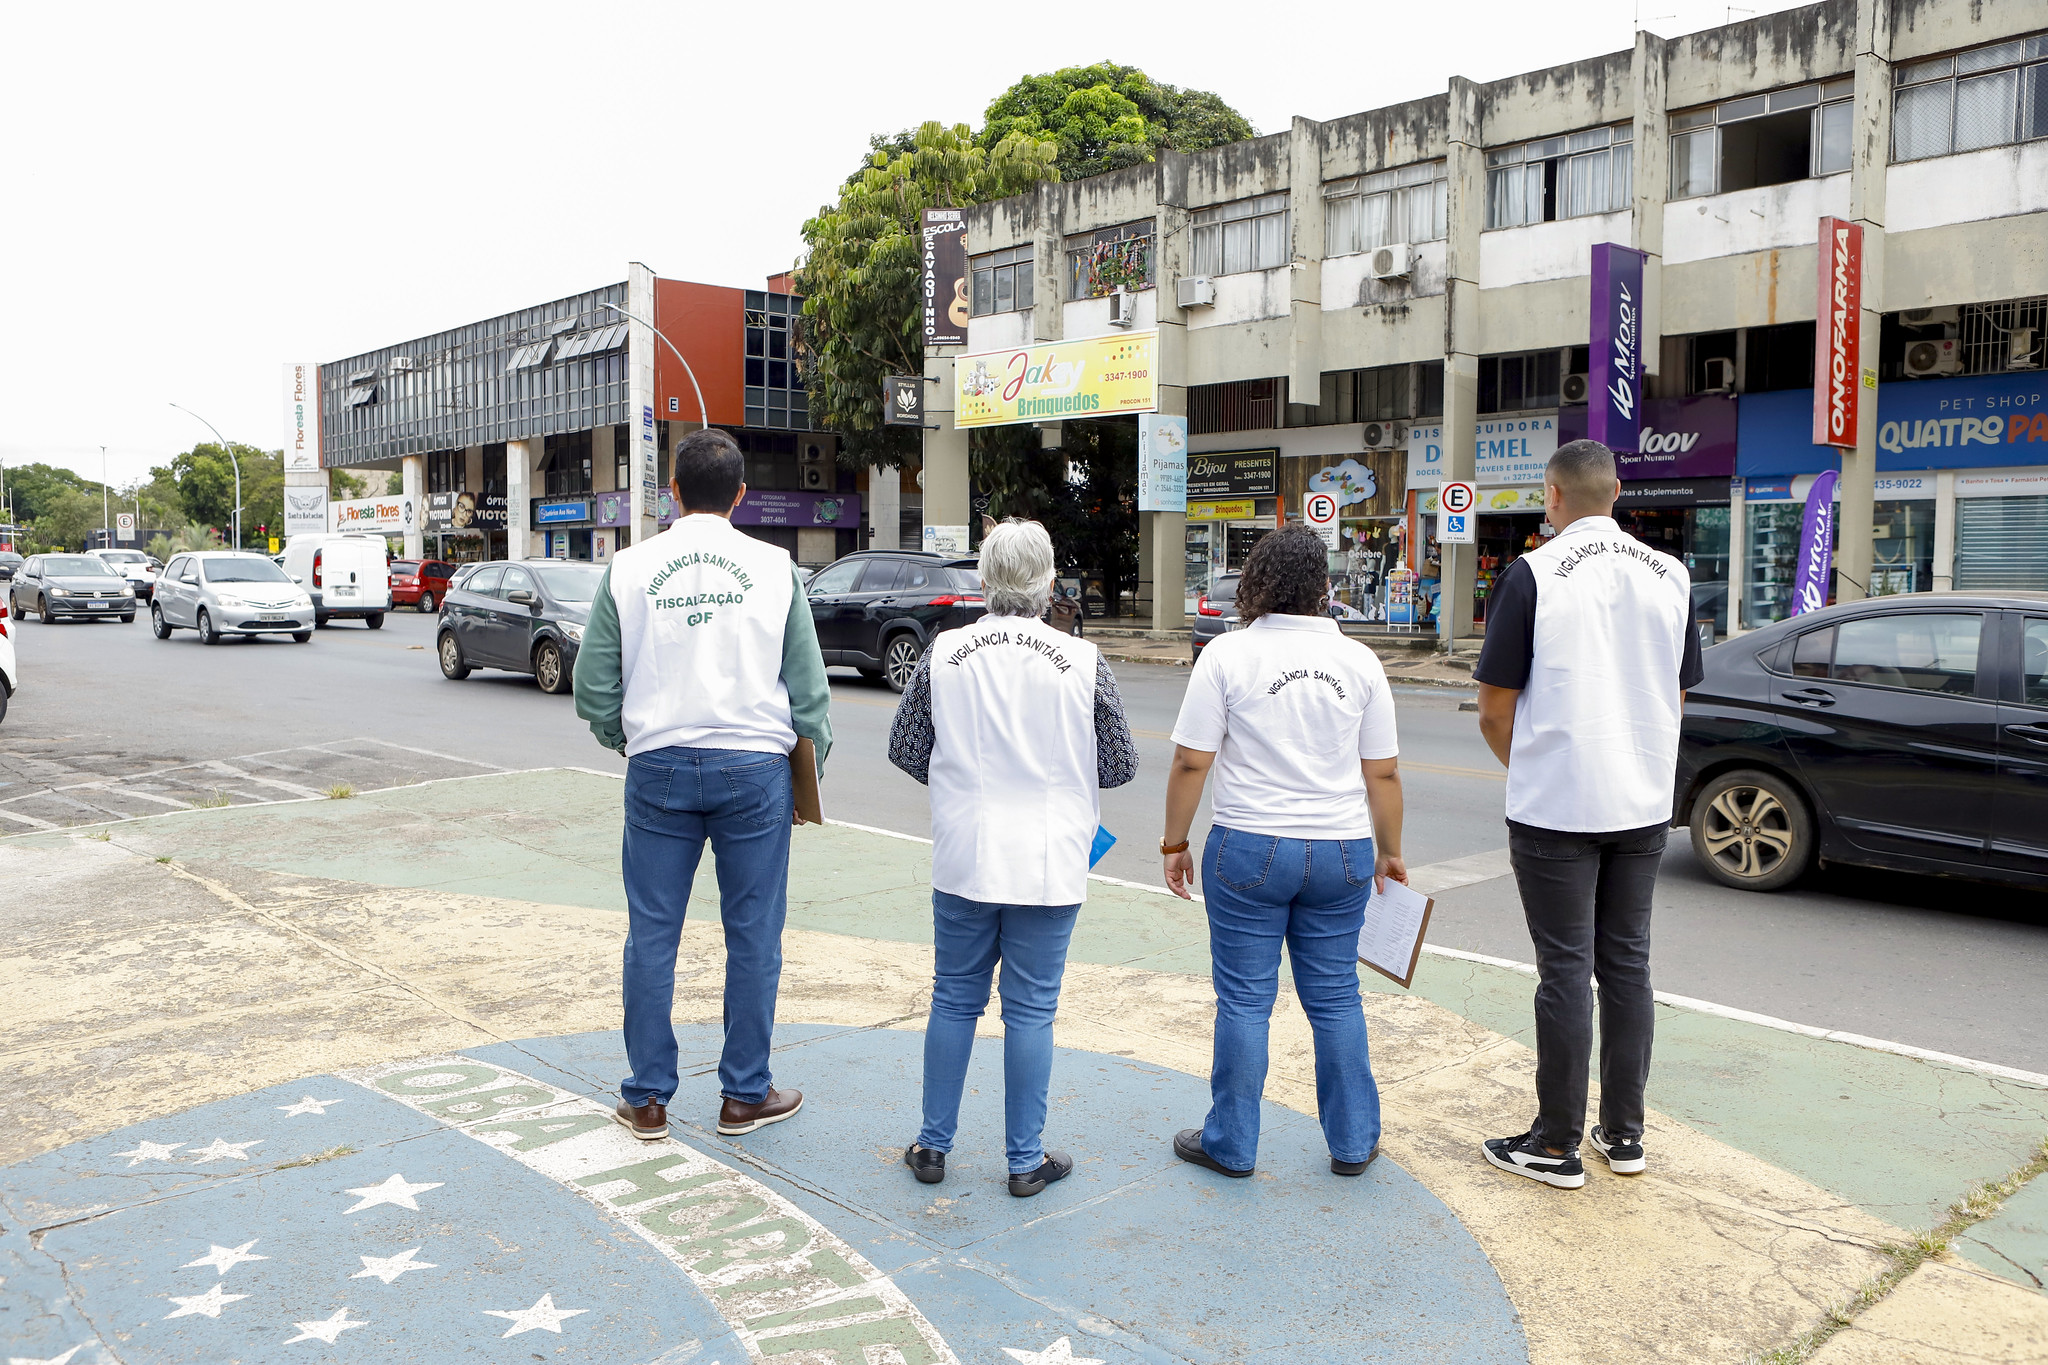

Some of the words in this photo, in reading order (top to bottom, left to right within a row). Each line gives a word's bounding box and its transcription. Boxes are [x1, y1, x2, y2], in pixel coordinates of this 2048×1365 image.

[923, 221, 966, 237] ESCOLA
[925, 241, 935, 336] CAVAQUINHO
[1831, 228, 1849, 437] ONOFARMA
[294, 365, 303, 402] Flores
[1104, 369, 1148, 382] 3347-1900
[670, 398, 677, 411] E
[1017, 391, 1100, 416] Brinquedos
[1940, 398, 1975, 411] PET
[1986, 393, 2041, 408] SHOP
[295, 404, 304, 450] Floresta
[1878, 415, 2004, 454] QUATRO
[1140, 431, 1149, 496] Pijamas
[1153, 459, 1185, 470] Pijamas
[1194, 457, 1228, 478] Bijou
[1234, 459, 1272, 468] PRESENTES
[1243, 470, 1272, 480] 3347-1900
[1320, 471, 1352, 483] Sonho
[1344, 482, 1365, 496] Cor
[1450, 489, 1464, 507] E
[1643, 488, 1694, 498] Suplementos
[346, 504, 375, 521] Floresta
[376, 503, 400, 519] Flores
[475, 509, 508, 520] VICTO
[1215, 504, 1243, 515] Brinquedos
[1315, 500, 1328, 517] E
[122, 518, 128, 526] E
[1348, 550, 1382, 559] Celebre
[1554, 541, 1608, 578] VIGILÂNCIA
[1613, 542, 1667, 579] SANITÁRIA
[647, 552, 700, 596] VIGILÂNCIA
[703, 552, 753, 592] SANITÁRIA
[948, 632, 1010, 667] VIGILÂNCIA
[1016, 633, 1071, 675] SANITÁRIA
[1267, 669, 1308, 696] VIGILÂNCIA
[1313, 670, 1346, 700] SANITÁRIA
[374, 1063, 618, 1152] OBA
